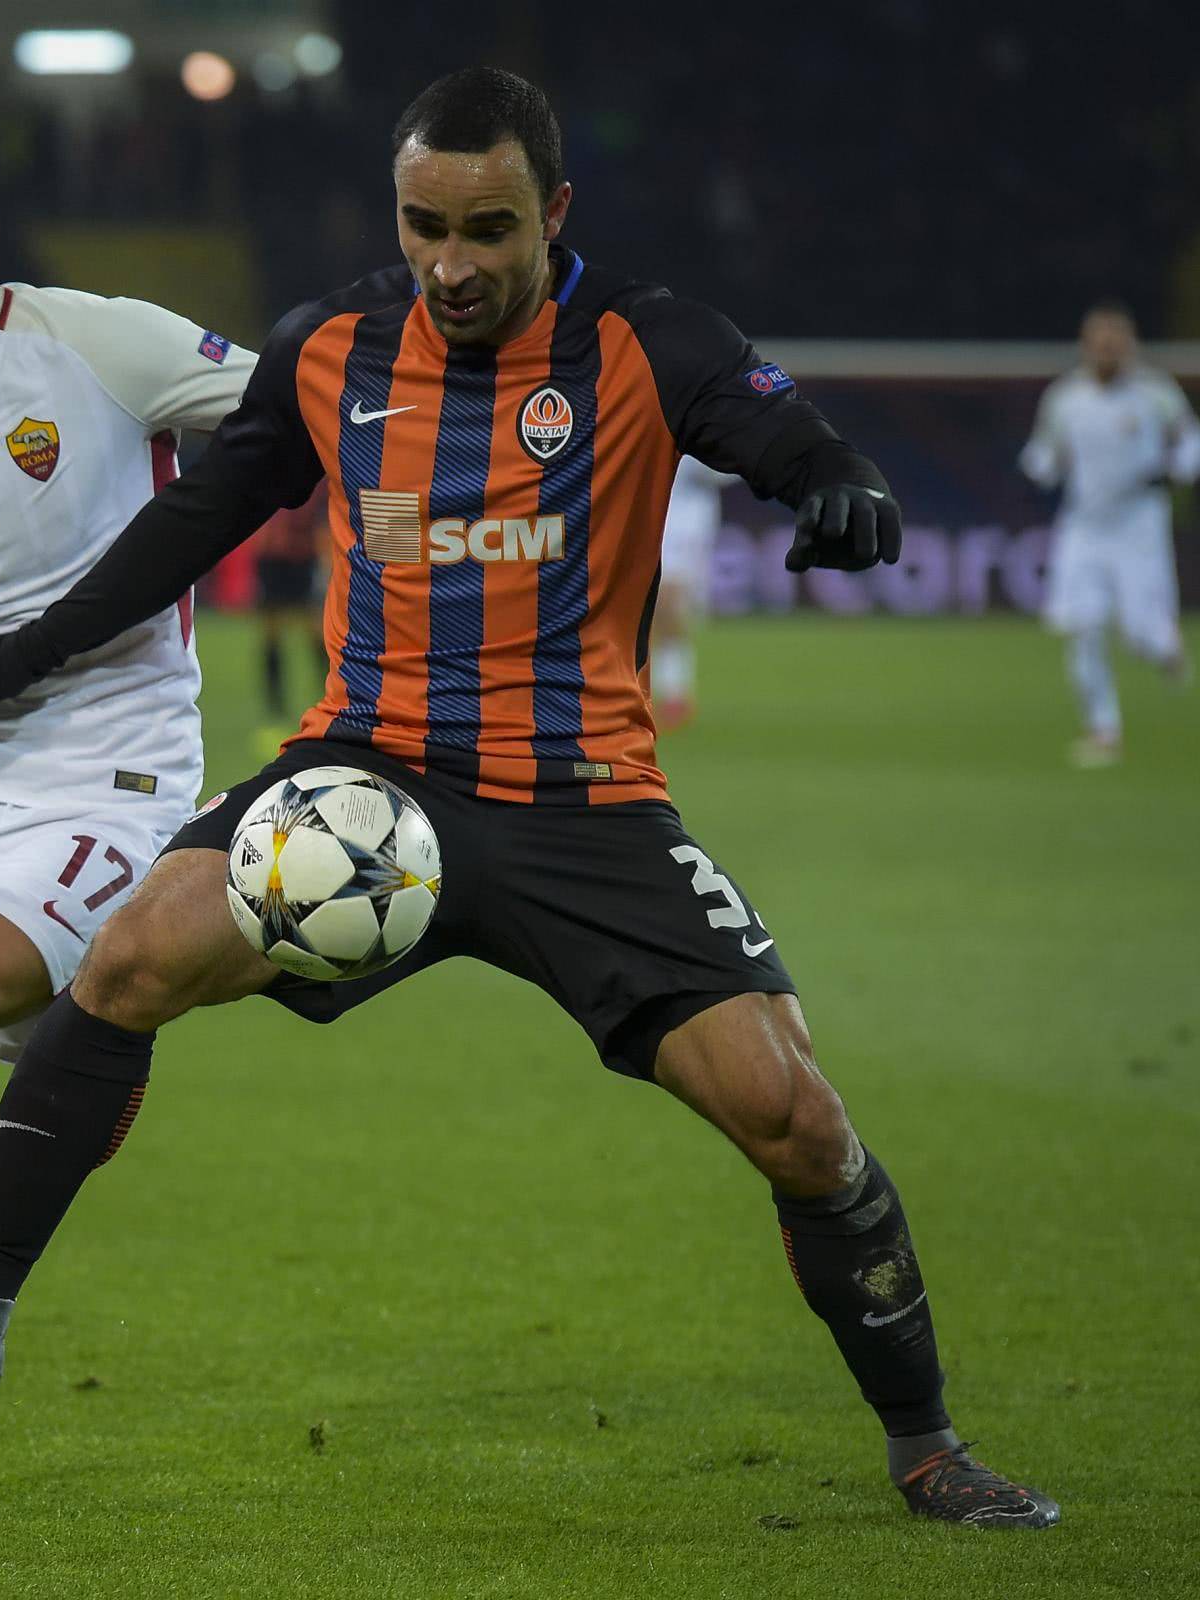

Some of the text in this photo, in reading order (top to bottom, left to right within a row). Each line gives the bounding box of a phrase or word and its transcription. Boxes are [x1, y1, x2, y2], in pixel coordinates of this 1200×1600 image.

[525, 425, 569, 436] ШАХТАР
[20, 450, 56, 469] ROMA
[427, 515, 565, 563] SCM
[244, 837, 263, 862] adidas
[58, 835, 133, 912] 17
[669, 845, 767, 930] 3
